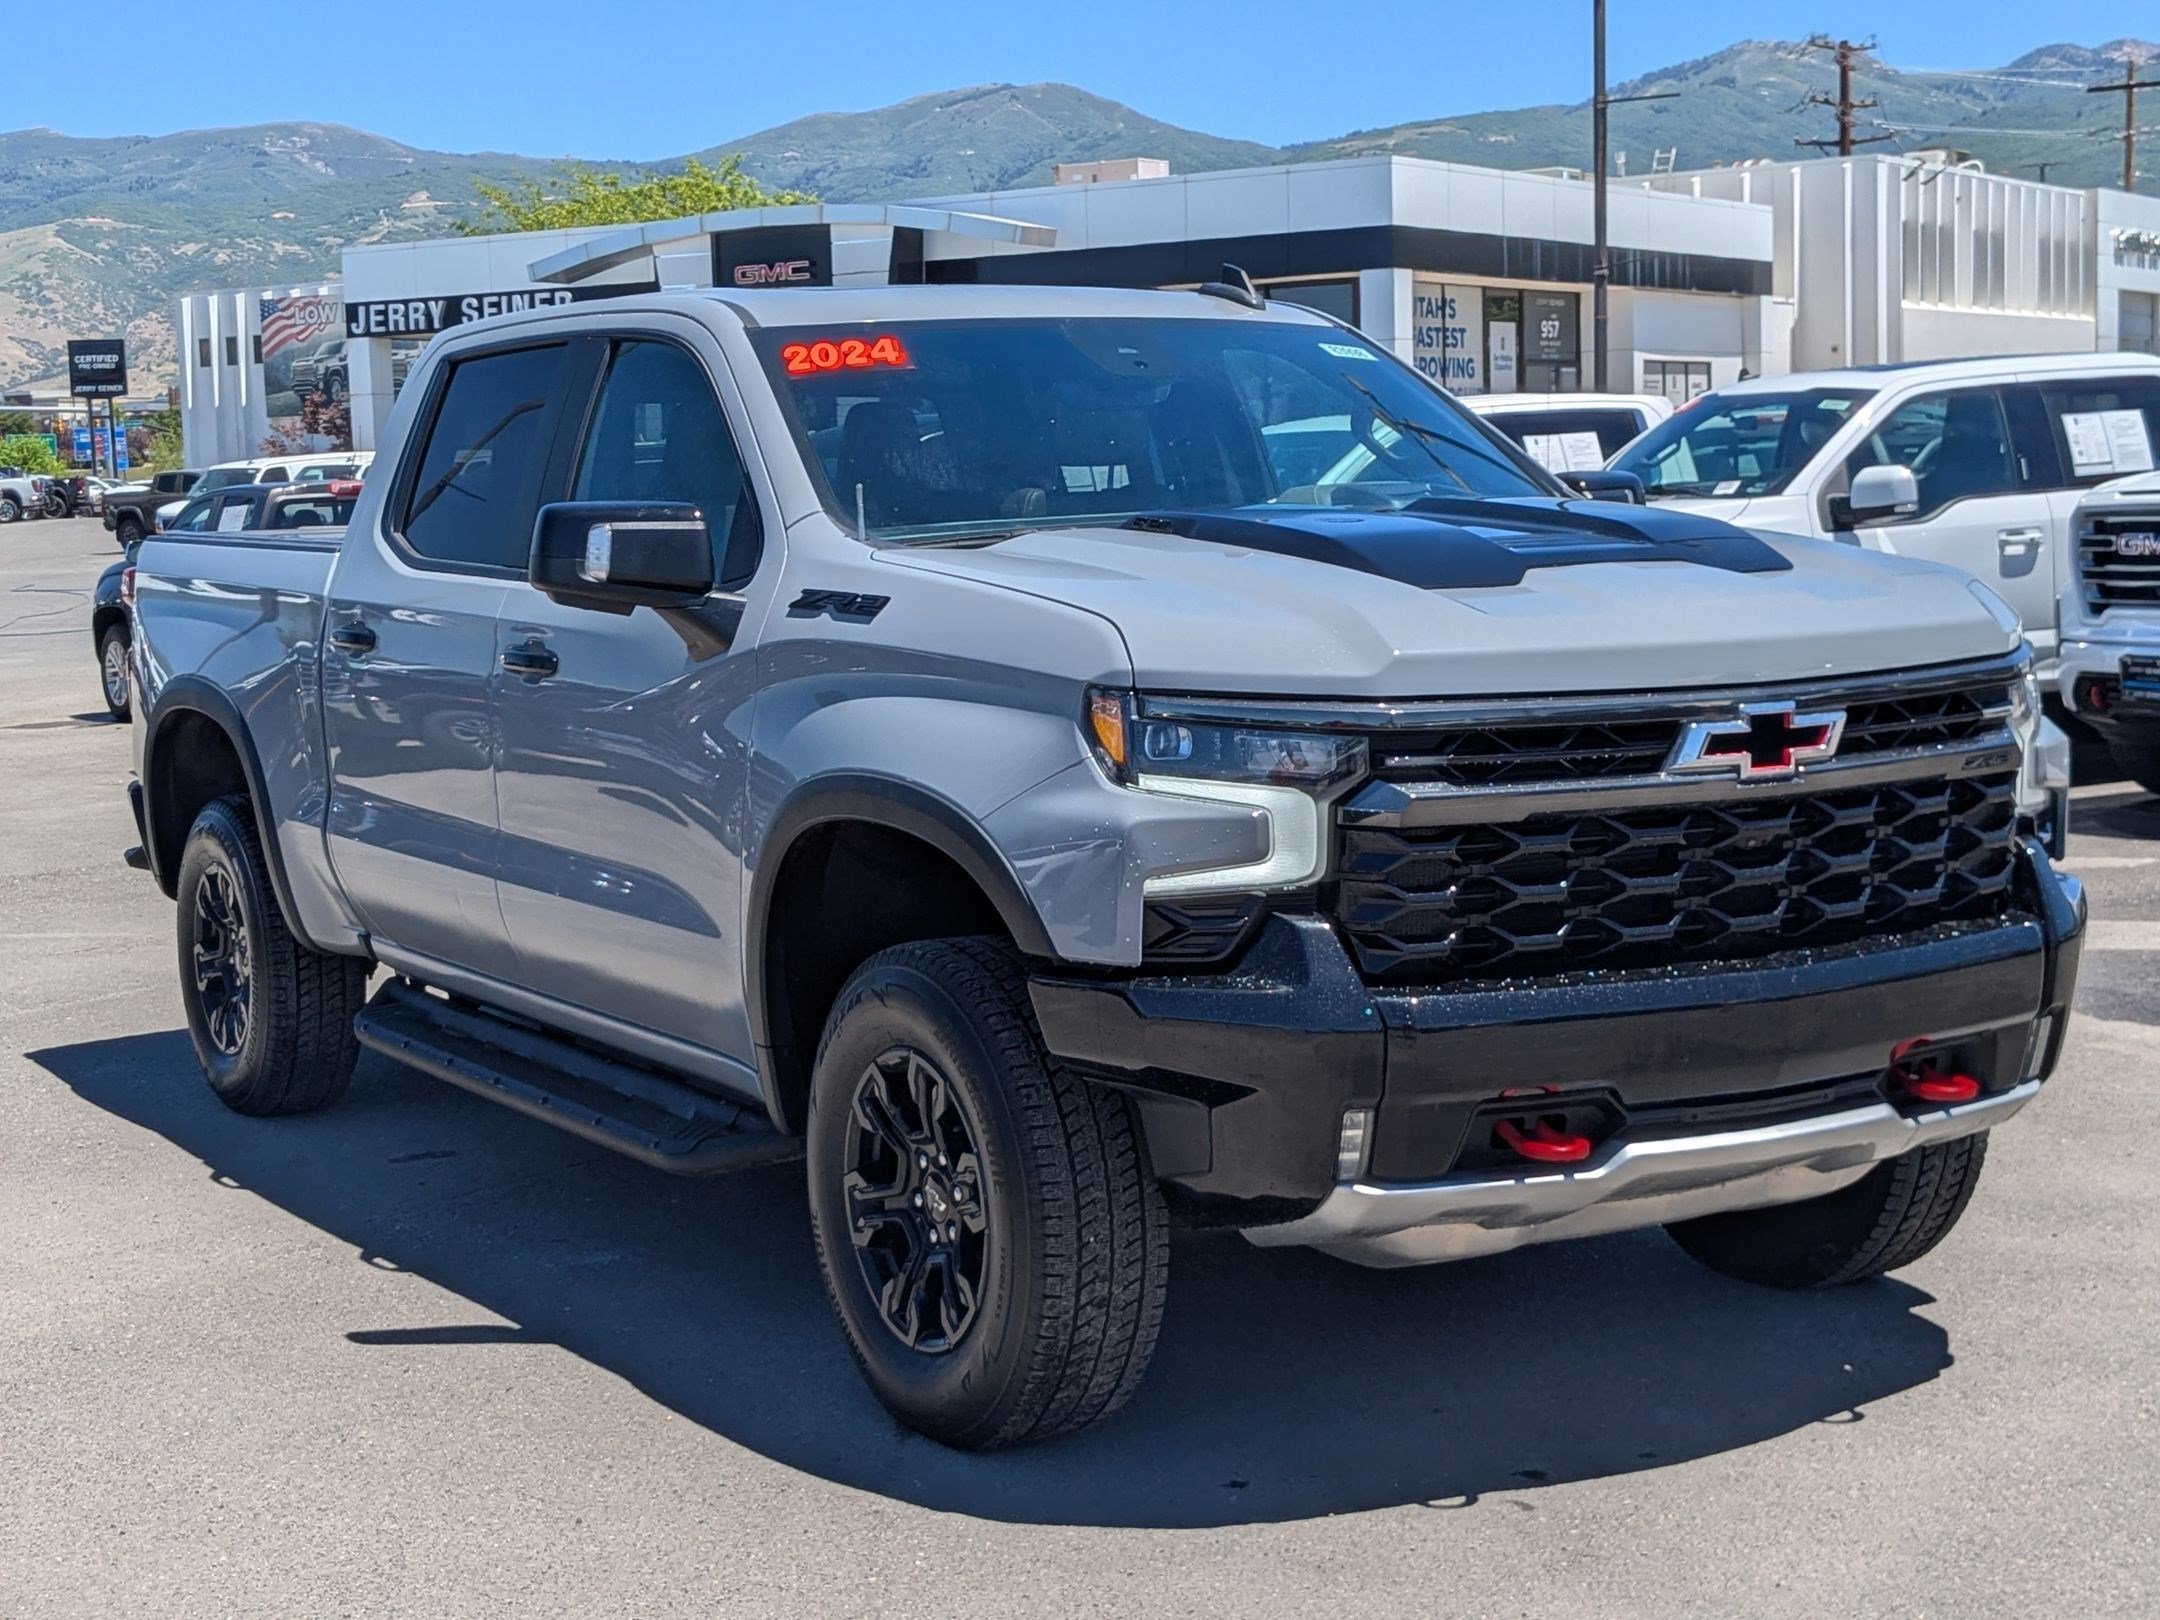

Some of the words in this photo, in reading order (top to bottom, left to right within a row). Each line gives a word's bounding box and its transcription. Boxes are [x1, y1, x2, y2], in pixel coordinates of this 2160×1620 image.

[734, 261, 810, 285] GMC
[294, 302, 337, 325] LOW
[351, 301, 446, 334] JERRY
[1413, 326, 1466, 349] ASTEST
[74, 354, 119, 364] CERTIFIED
[781, 335, 907, 376] 2024
[1413, 355, 1475, 379] ROWING
